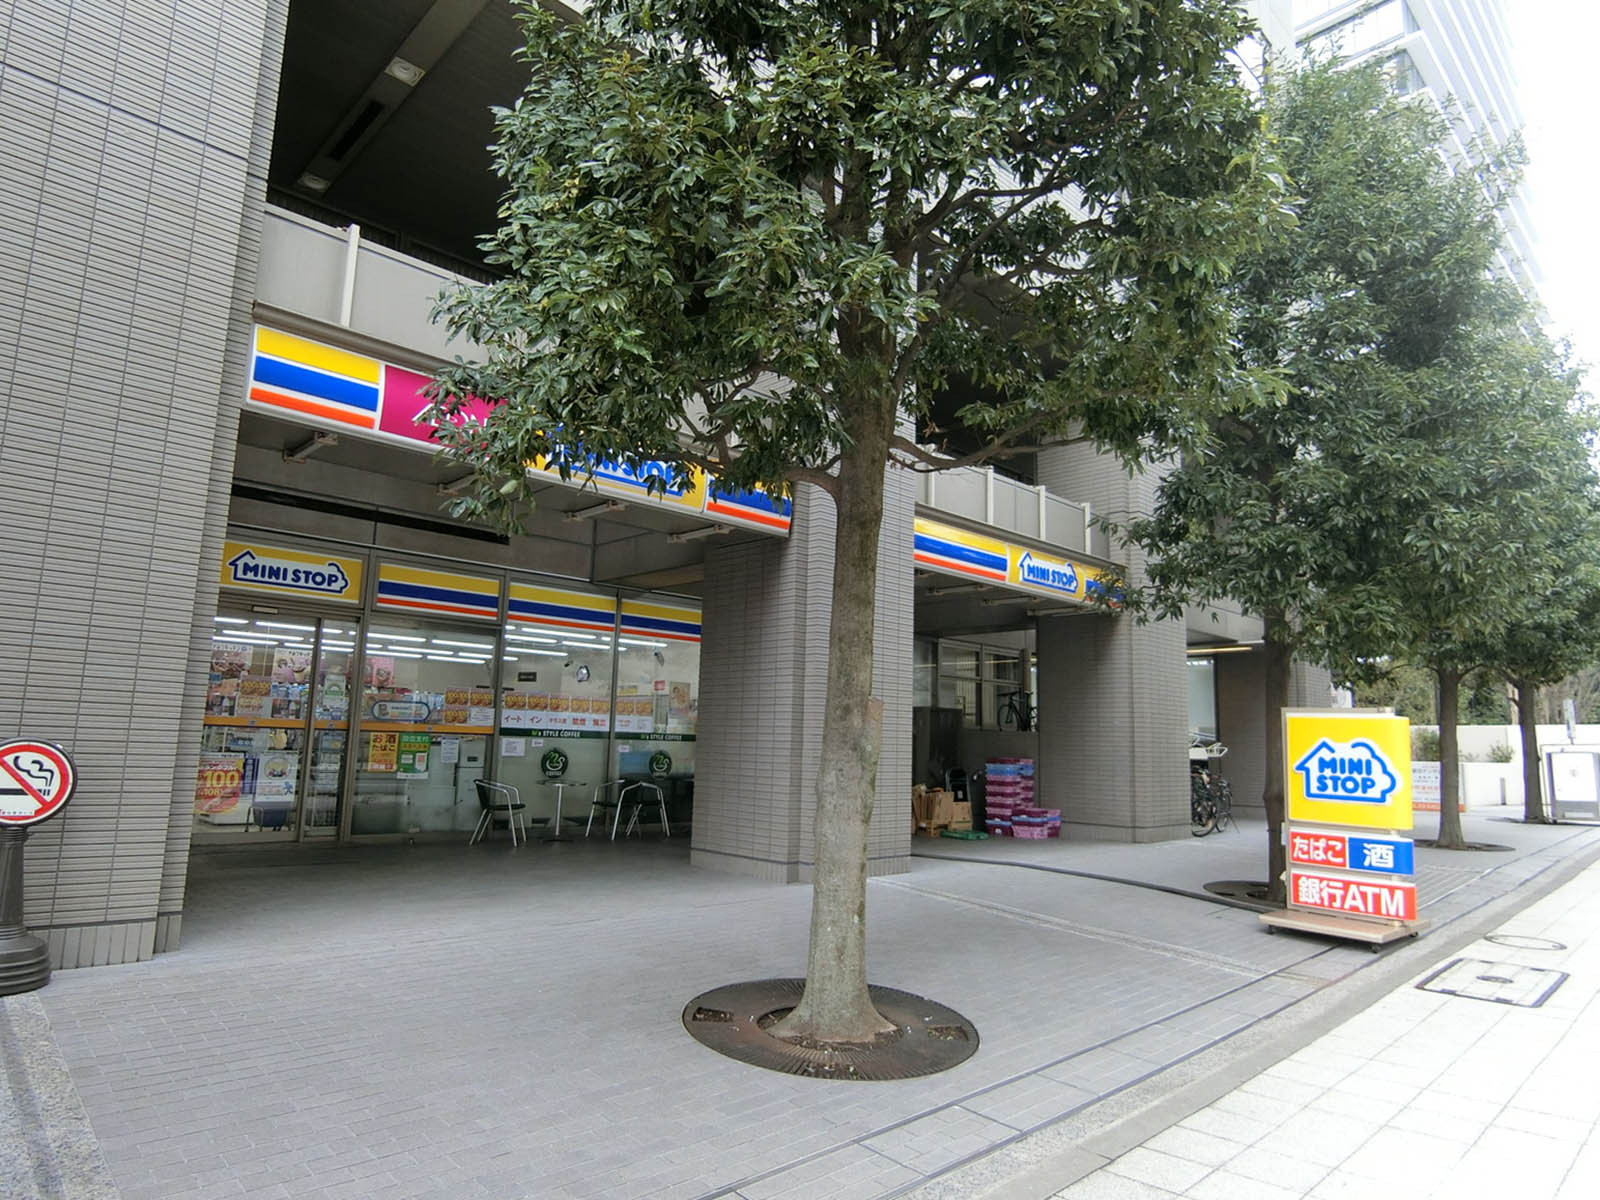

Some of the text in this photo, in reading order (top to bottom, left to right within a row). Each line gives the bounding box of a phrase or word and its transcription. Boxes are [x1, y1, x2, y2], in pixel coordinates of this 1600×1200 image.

[242, 562, 340, 587] MINI STOP
[1026, 563, 1075, 588] MINI STOP
[560, 730, 581, 739] COFFEE
[1318, 756, 1373, 775] MINI
[1316, 775, 1376, 795] STOP
[1292, 836, 1395, 868] たばこ 酒
[1298, 876, 1405, 917] 銀行ATM
